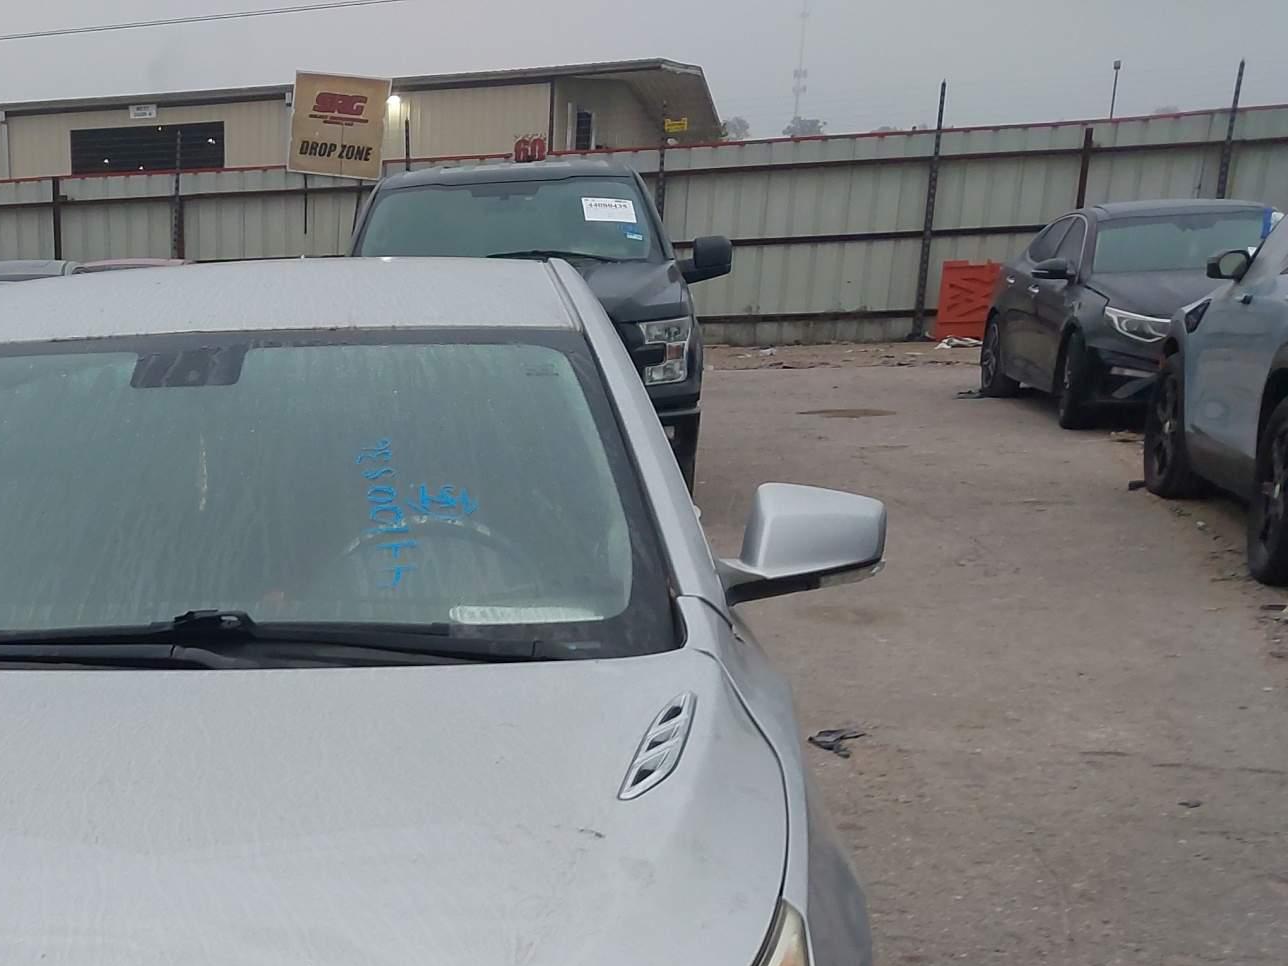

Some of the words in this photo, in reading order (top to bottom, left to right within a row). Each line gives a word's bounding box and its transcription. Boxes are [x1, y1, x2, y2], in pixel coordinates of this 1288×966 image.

[312, 92, 368, 115] SRG
[299, 140, 337, 158] DROP
[338, 144, 373, 161] ZONE
[514, 137, 546, 162] 60
